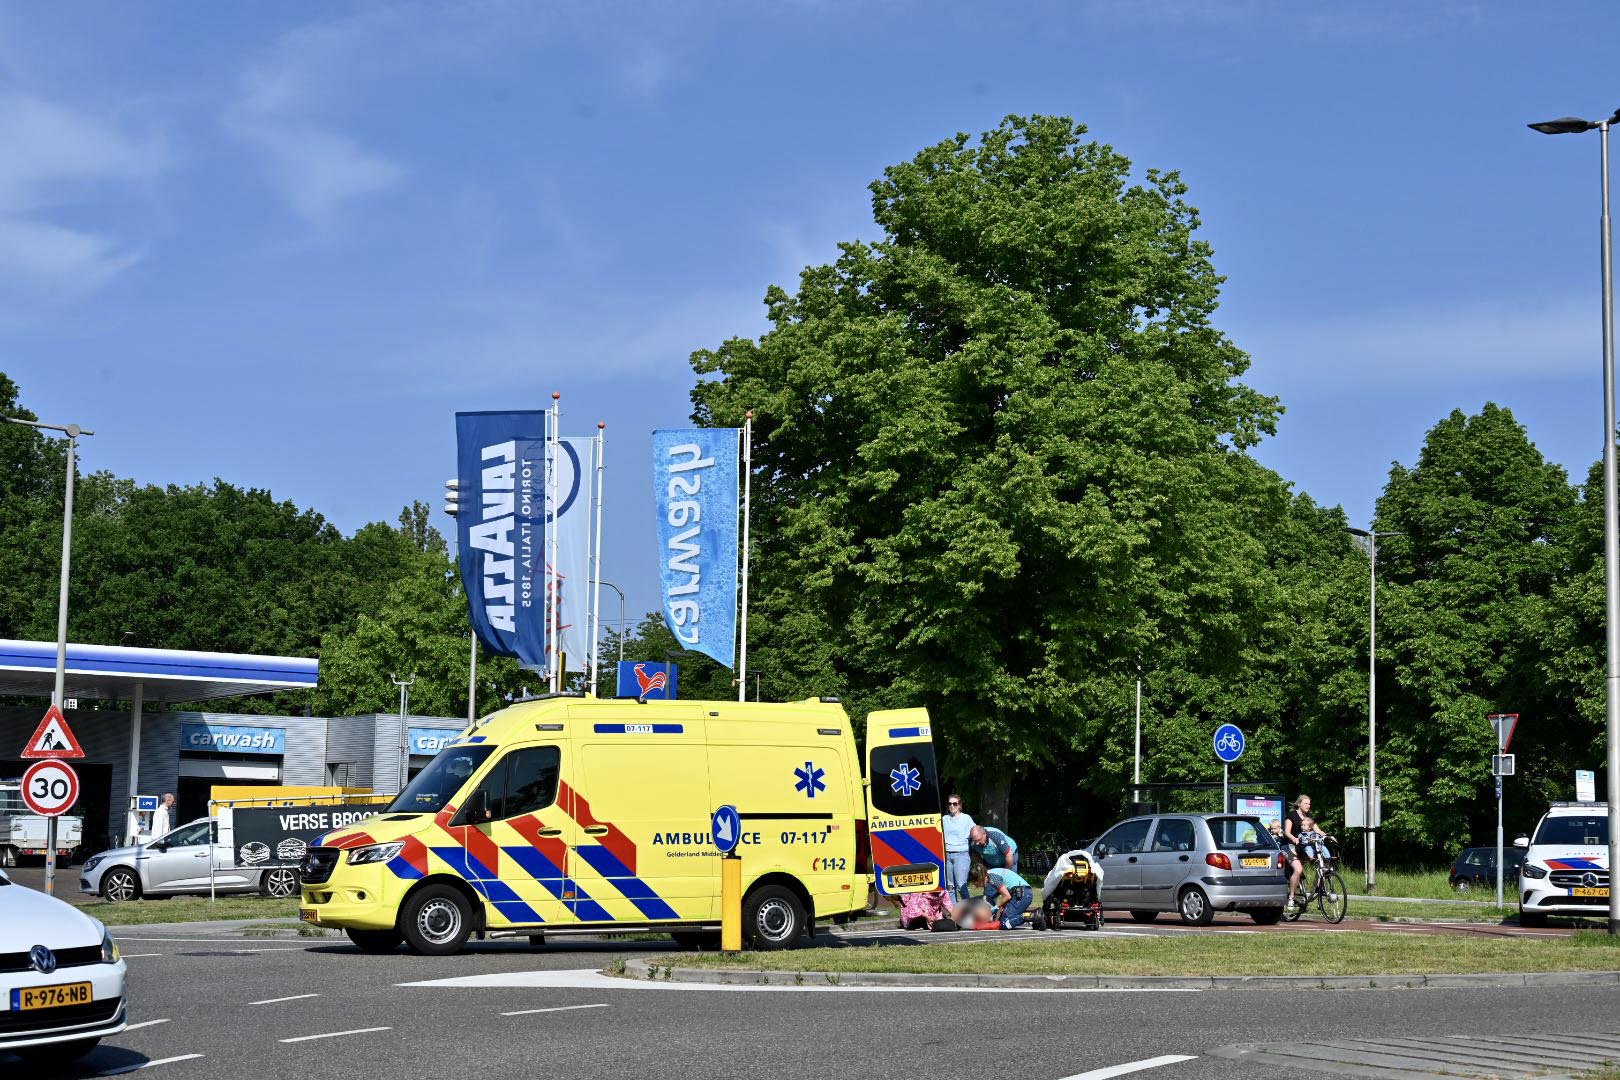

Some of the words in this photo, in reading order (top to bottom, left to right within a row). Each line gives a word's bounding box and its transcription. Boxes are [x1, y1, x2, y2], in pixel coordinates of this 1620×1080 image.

[189, 731, 275, 748] carwash
[417, 736, 453, 750] car
[32, 777, 68, 800] 30
[279, 813, 329, 831] VERSE
[332, 811, 379, 829] BRO
[870, 817, 935, 829] AMBULANCE
[652, 832, 761, 845] AMBULCE
[780, 831, 827, 844] 07-117
[821, 858, 846, 871] 1-1-2
[894, 873, 930, 884] K-587-RK
[24, 986, 88, 1007] R-976-NB
